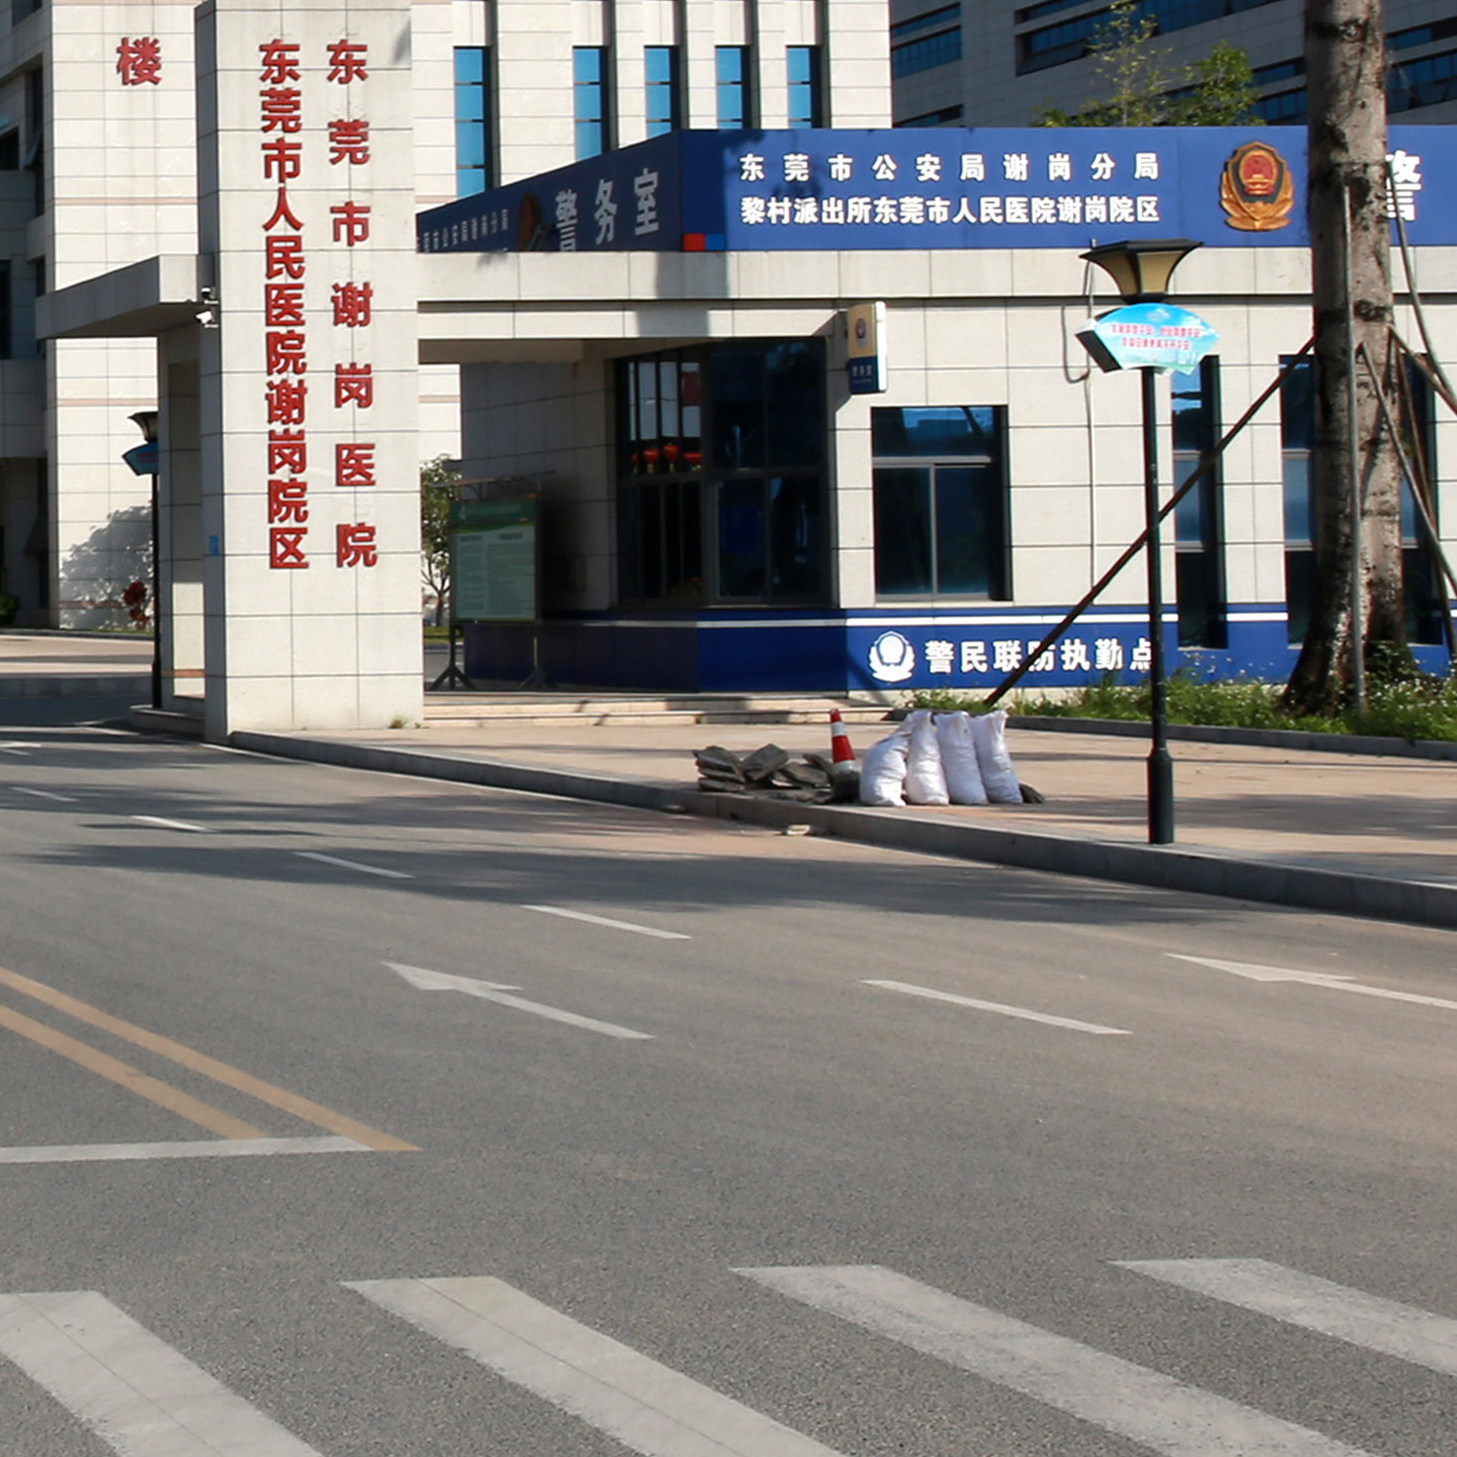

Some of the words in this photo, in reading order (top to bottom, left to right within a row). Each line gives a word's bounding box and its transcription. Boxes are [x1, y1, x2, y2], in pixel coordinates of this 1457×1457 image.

[739, 153, 1159, 182] 东莞市公安局谢岗分局
[555, 167, 660, 252] 警务室
[739, 195, 1160, 225] 黎村派出所东莞市人民医院谢岗院区
[259, 39, 309, 570] 东莞市人民医院谢岗院区
[327, 39, 378, 568] 东莞市谢岗医院
[924, 638, 1153, 675] 警民联防执勤点
